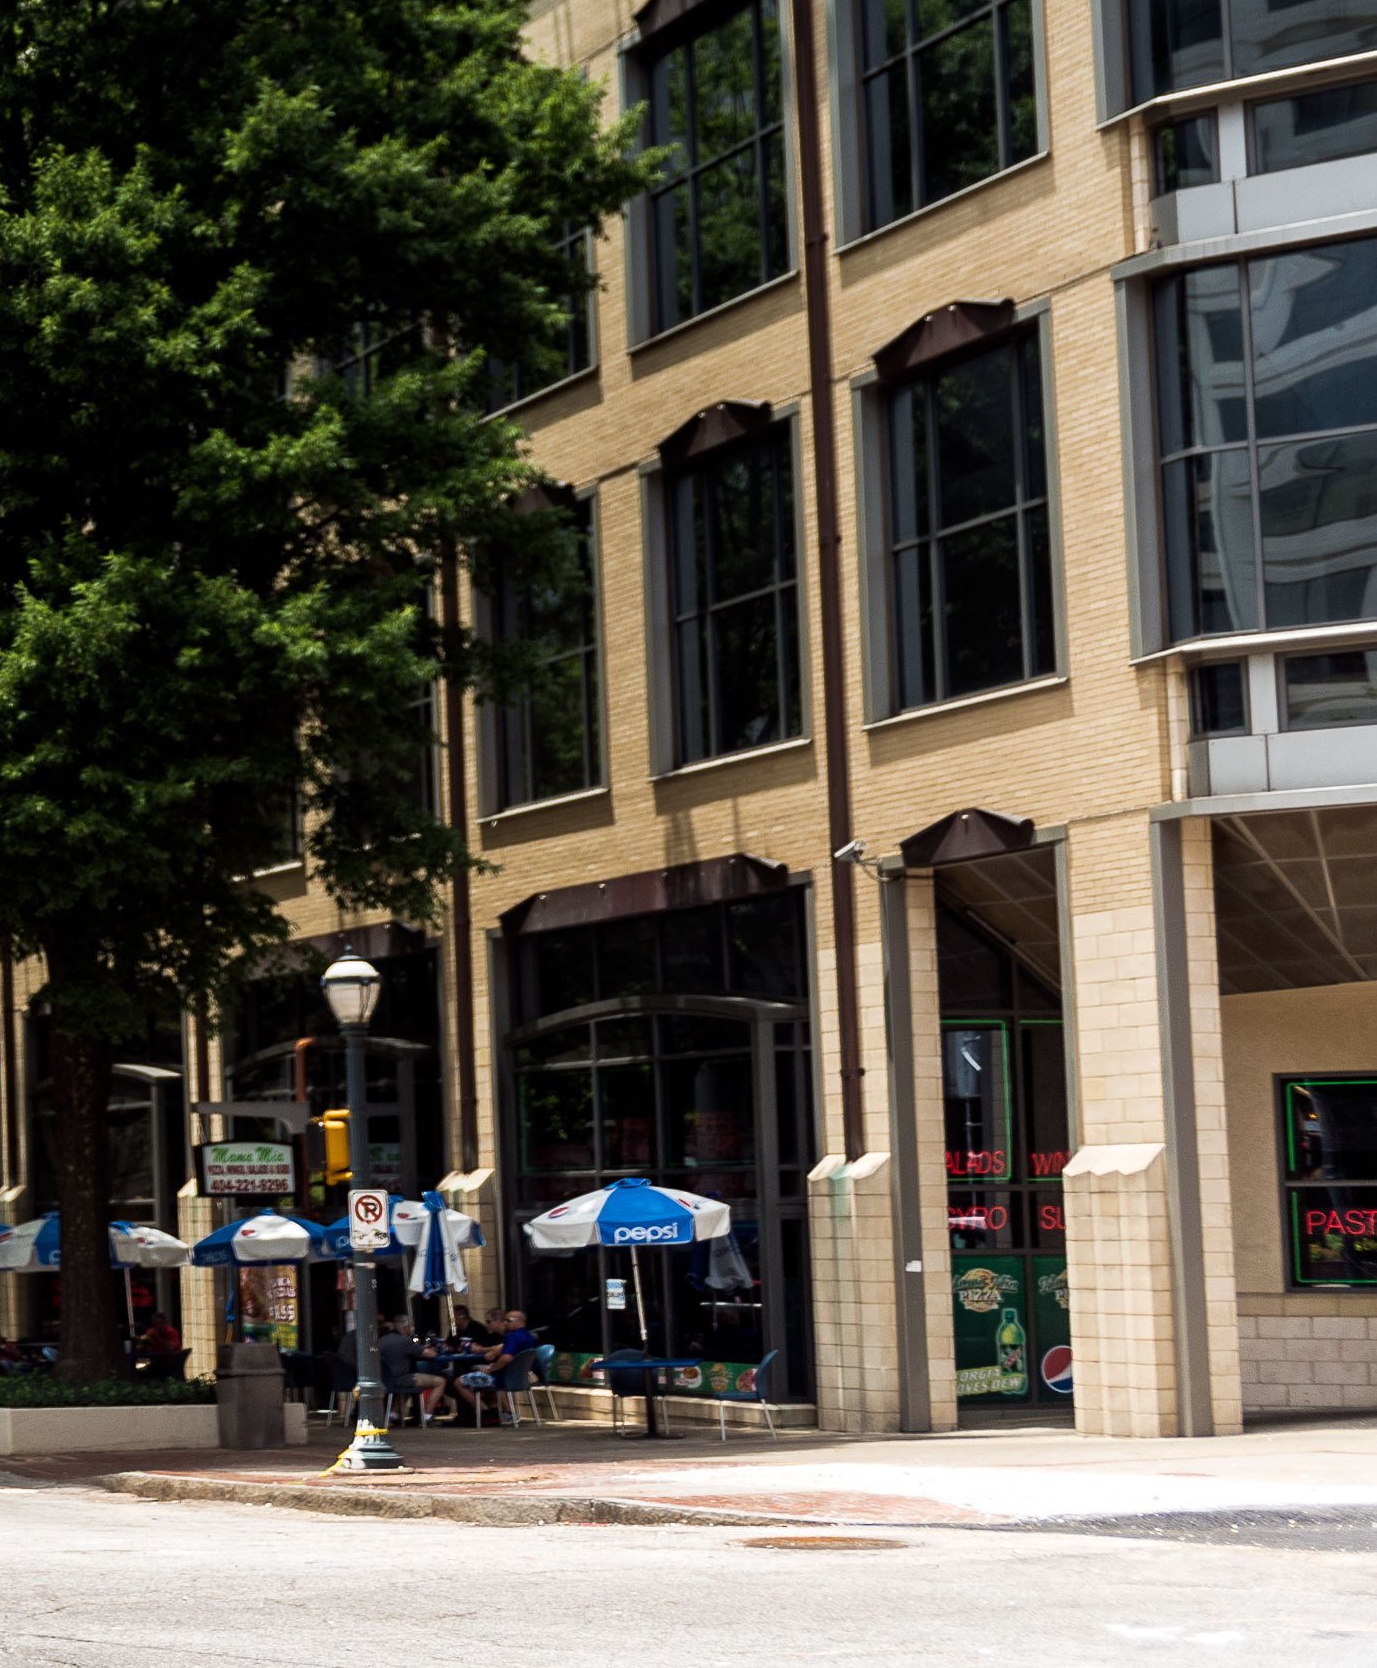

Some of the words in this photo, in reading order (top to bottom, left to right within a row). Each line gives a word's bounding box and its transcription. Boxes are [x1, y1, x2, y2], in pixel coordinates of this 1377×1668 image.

[1030, 1150, 1071, 1177] WIN
[1040, 1205, 1067, 1231] SU
[1306, 1210, 1377, 1235] PAST
[613, 1222, 679, 1245] pepsi
[958, 1289, 1003, 1303] PIZZA
[959, 1368, 1001, 1382] ORGIA
[957, 1381, 988, 1394] OVES
